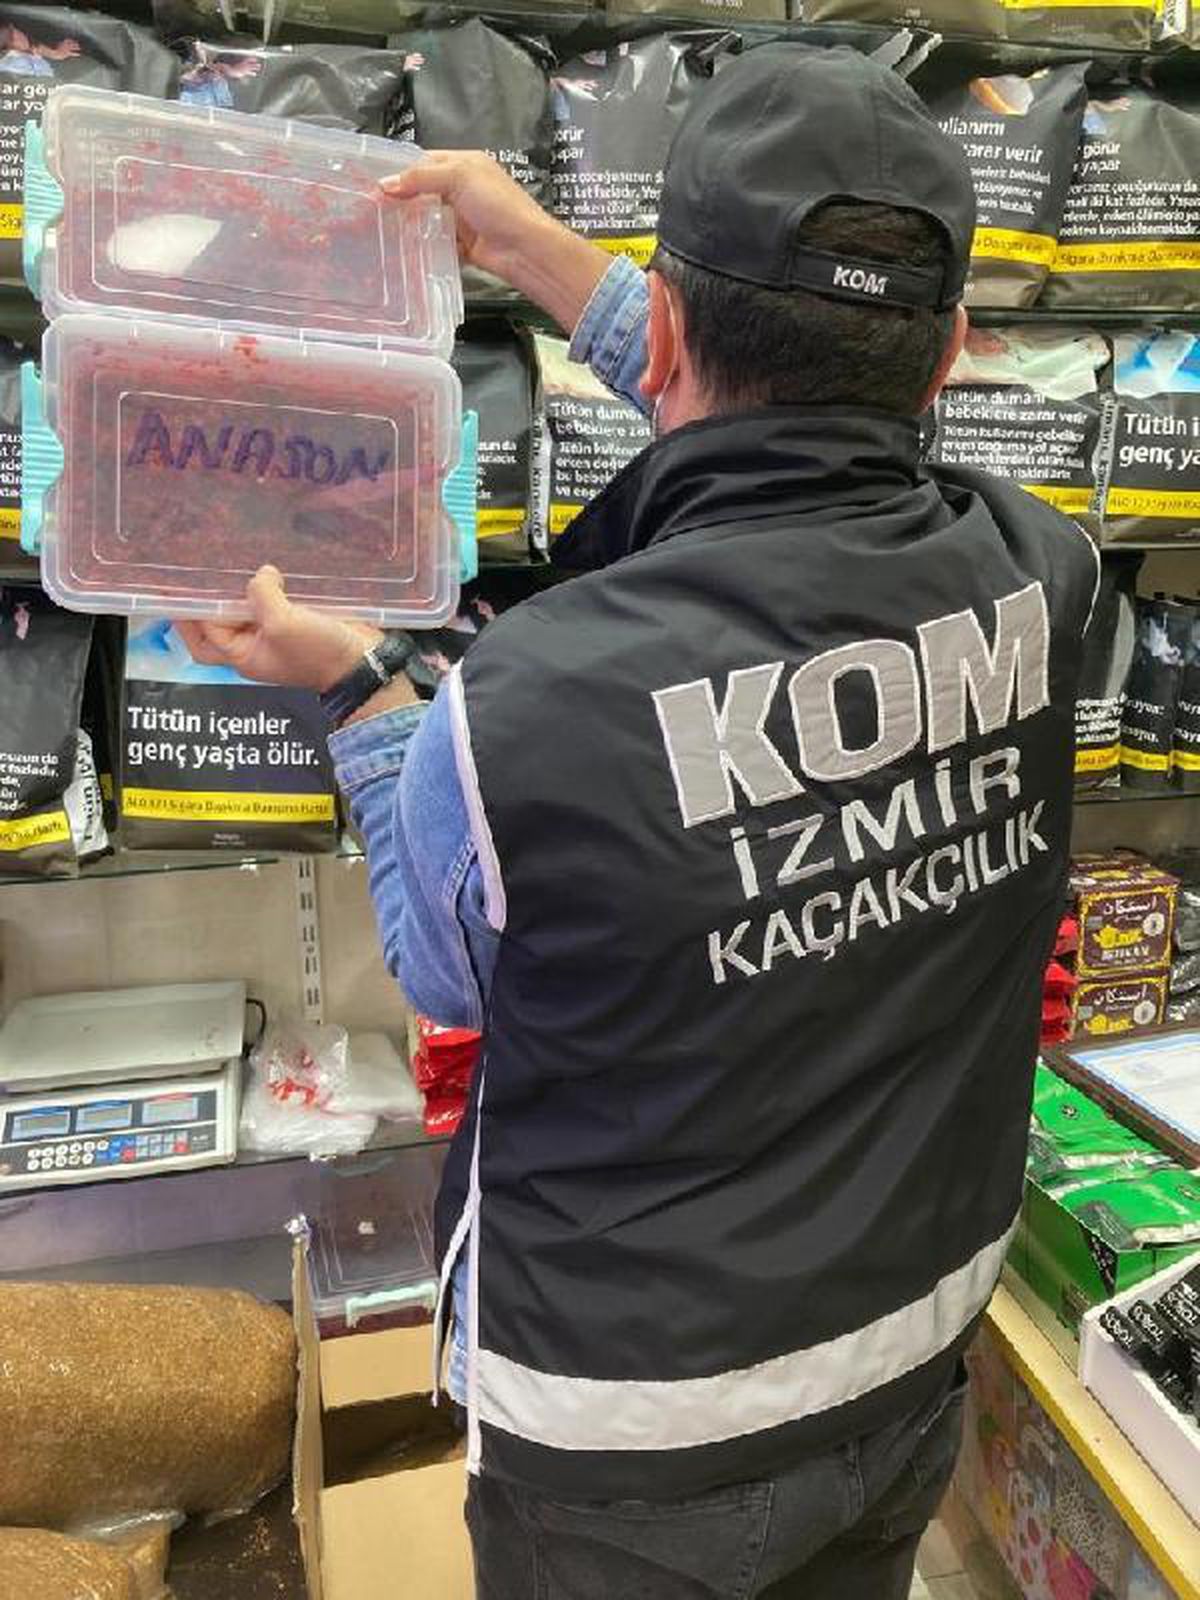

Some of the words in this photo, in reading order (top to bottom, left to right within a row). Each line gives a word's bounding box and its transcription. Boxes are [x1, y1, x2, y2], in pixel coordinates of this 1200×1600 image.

[1005, 144, 1044, 164] verir
[833, 265, 890, 296] KOM
[1124, 412, 1187, 436] Tütün
[127, 409, 391, 485] ANASON
[1119, 444, 1175, 471] genç
[651, 581, 1050, 828] KOM
[128, 707, 201, 733] Tütün
[209, 710, 291, 740] içenler
[128, 741, 187, 768] genç
[193, 743, 261, 770] yaşta
[267, 741, 320, 766] ölür.
[730, 746, 1022, 900] İZMİR
[707, 800, 1049, 985] KAÇAKÇILIK
